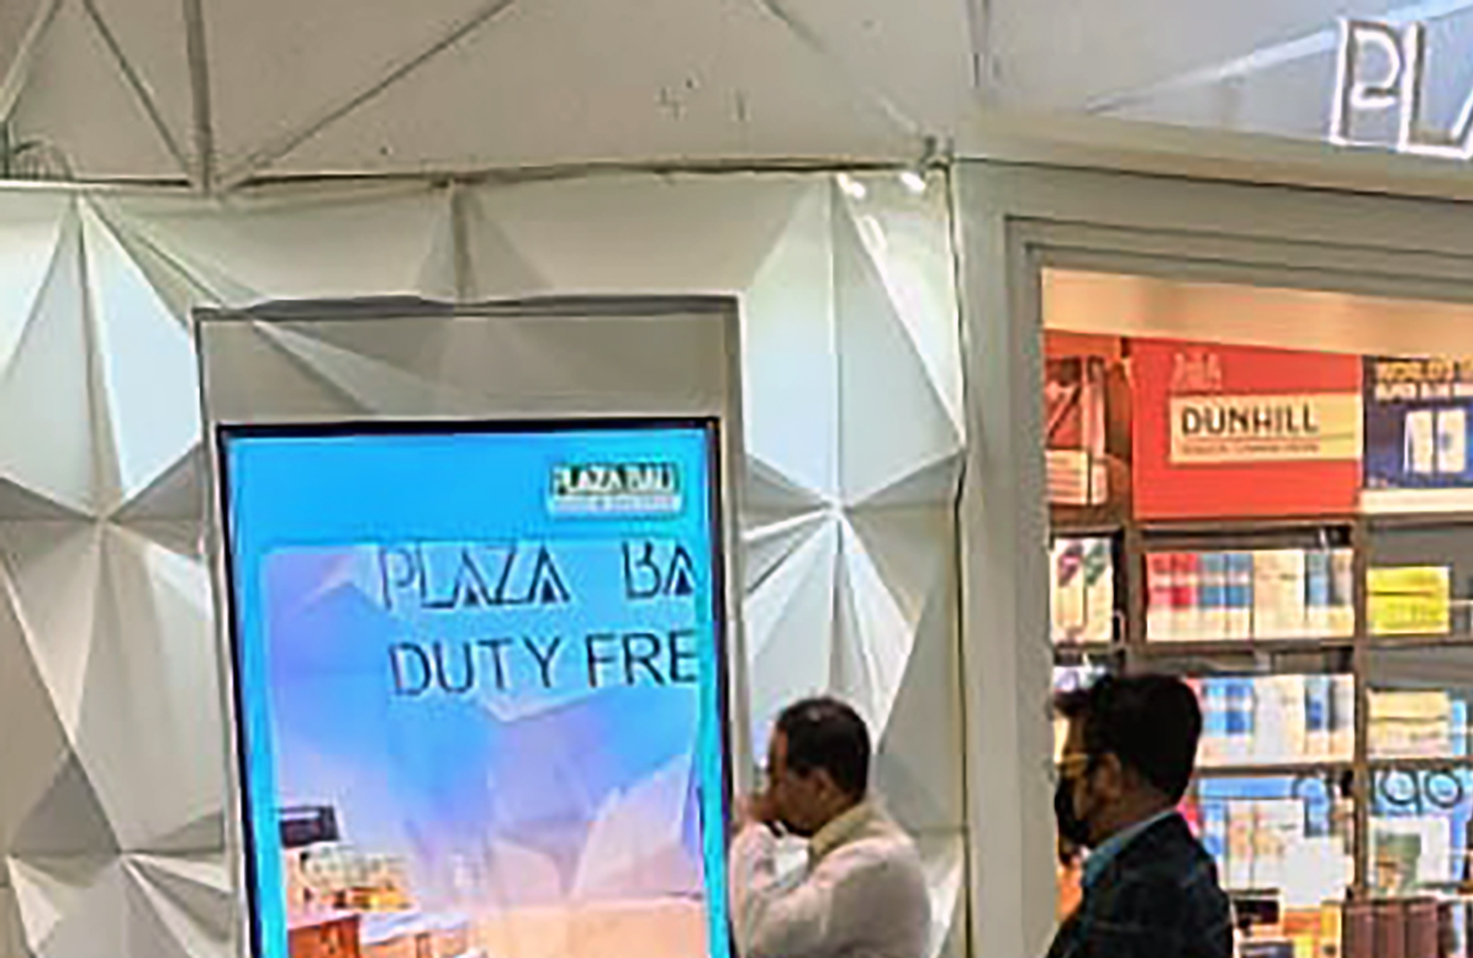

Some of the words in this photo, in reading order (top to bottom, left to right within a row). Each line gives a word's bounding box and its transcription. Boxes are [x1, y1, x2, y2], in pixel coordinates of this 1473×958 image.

[1181, 401, 1320, 436] DUNHILL
[379, 540, 571, 610] PLAZA
[388, 636, 562, 696] DUTY
